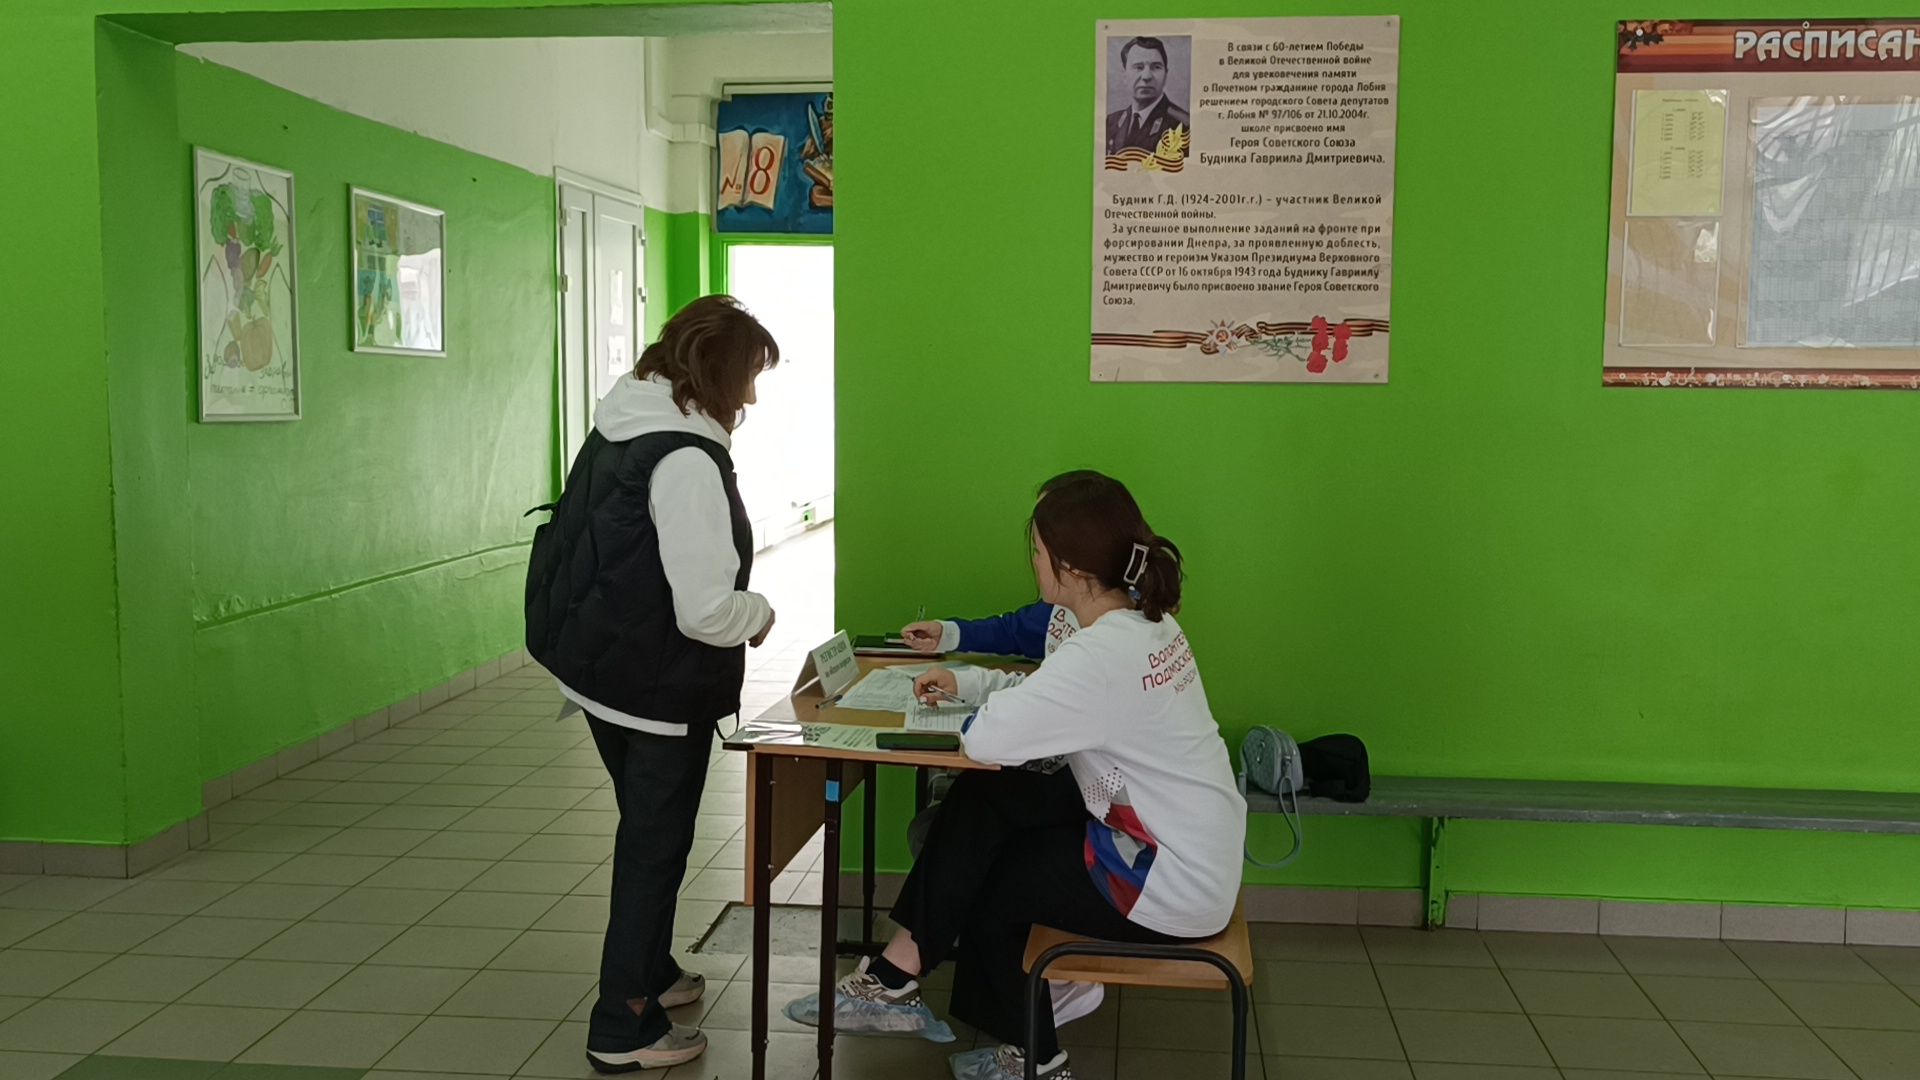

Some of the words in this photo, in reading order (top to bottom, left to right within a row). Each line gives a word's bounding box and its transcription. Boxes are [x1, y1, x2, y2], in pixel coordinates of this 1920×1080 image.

[1228, 42, 1233, 52] В
[1236, 43, 1263, 52] связи
[1265, 43, 1270, 51] с
[1273, 42, 1324, 51] 60-летием
[1327, 41, 1364, 52] Победы
[1219, 58, 1225, 66] в
[1228, 56, 1267, 65] Великой
[1270, 56, 1340, 64] Отечественной
[1343, 56, 1372, 64] войне
[1253, 71, 1319, 80] увековечения
[1212, 83, 1257, 92] Почетном
[1261, 85, 1318, 93] гражданине
[1321, 84, 1354, 94] города
[1357, 82, 1386, 91] Лобня
[1200, 99, 1248, 107] решением
[1251, 98, 1303, 107] городского
[1307, 96, 1338, 106] Совета
[1340, 97, 1389, 107] депутатов
[1227, 110, 1256, 119] Лобня
[1259, 110, 1269, 119] №
[1272, 110, 1302, 119] 97/106
[1305, 111, 1314, 119] от
[1241, 125, 1271, 133] школе
[1274, 125, 1324, 134] присвоено
[1230, 137, 1259, 149] Героя
[1263, 137, 1320, 147] Советского
[1324, 137, 1356, 147] Союза
[1200, 153, 1247, 166] Будника
[1250, 152, 1303, 165] Гавриила
[1306, 152, 1385, 165] Дмитриевича.
[750, 146, 775, 195] 8
[1112, 194, 1154, 206] Будник
[1158, 194, 1177, 205] Г.Д.
[1275, 196, 1329, 206] участник
[1333, 194, 1382, 204] Великой
[1104, 209, 1179, 219] Отечественной
[1181, 209, 1216, 218] войны.
[1112, 223, 1124, 233] За
[1127, 226, 1180, 235] успешное
[1183, 225, 1251, 234] выполнение
[1254, 224, 1299, 234] заданий
[1303, 225, 1315, 233] на
[1318, 223, 1358, 235] фронте
[1361, 225, 1380, 235] при
[1104, 238, 1184, 249] форсировании
[1187, 237, 1231, 249] Днепра,
[1248, 239, 1324, 249] проявленную
[1327, 237, 1380, 249] доблесть,
[1104, 254, 1154, 264] мужество
[1166, 254, 1208, 264] героизм
[1211, 253, 1249, 262] Указом
[1251, 252, 1316, 263] Президиума
[1319, 252, 1380, 264] Верховного
[1104, 266, 1137, 276] Совета
[1140, 266, 1163, 276] СССР
[1179, 266, 1189, 276] 16
[1190, 267, 1232, 278] октября
[1234, 266, 1256, 276] 1943
[1258, 269, 1282, 278] года
[1284, 266, 1328, 279] Буднику
[1330, 266, 1379, 279] Гавриилу
[1103, 281, 1171, 293] Дмитриевичу
[1173, 281, 1199, 291] было
[1201, 283, 1255, 293] присвоено
[1257, 283, 1291, 291] звание
[1293, 281, 1322, 293] Героя
[1324, 281, 1379, 291] Советского
[1103, 295, 1136, 305] Союза.
